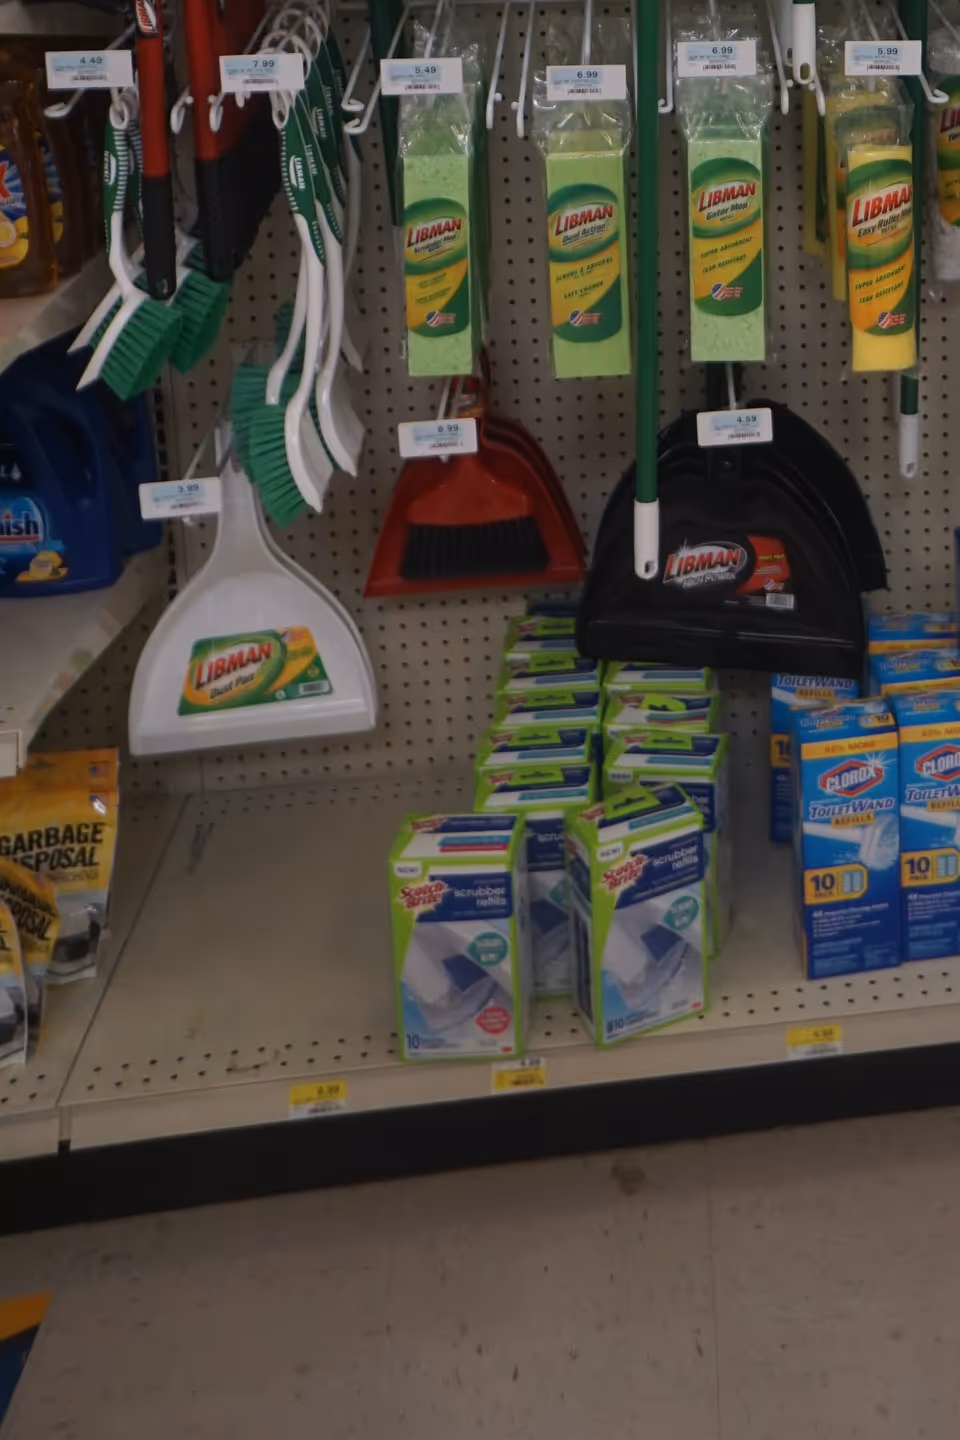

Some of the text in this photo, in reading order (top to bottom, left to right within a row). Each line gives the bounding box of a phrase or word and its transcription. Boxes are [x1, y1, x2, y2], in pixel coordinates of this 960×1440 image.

[712, 46, 733, 55] 6.99
[877, 47, 898, 56] 5.99
[253, 60, 275, 68] 7.99
[415, 66, 437, 75] 5.49
[577, 70, 599, 79] 6.99
[294, 157, 305, 190] LIBMAN
[699, 182, 756, 211] LIBMAN
[555, 205, 613, 235] LIBMAN
[706, 202, 748, 221] Gator Mop
[407, 217, 462, 249] LIBMAN
[562, 225, 606, 243] Dual Action
[858, 215, 900, 238] Easy Roller
[736, 415, 757, 424] 4.59
[663, 549, 740, 580] LIBMAN
[194, 642, 272, 691] LIBMAN
[209, 672, 255, 699] Dust Pan
[826, 764, 876, 793] CLOROX
[653, 845, 698, 866] scrubber
[672, 855, 698, 871] refills
[906, 857, 930, 875] 10
[399, 882, 446, 900] Scotch
[810, 873, 835, 892] 10
[405, 893, 443, 909] Brite
[454, 886, 506, 898] scrubber
[476, 896, 506, 906] refills
[407, 1034, 420, 1049] 10
